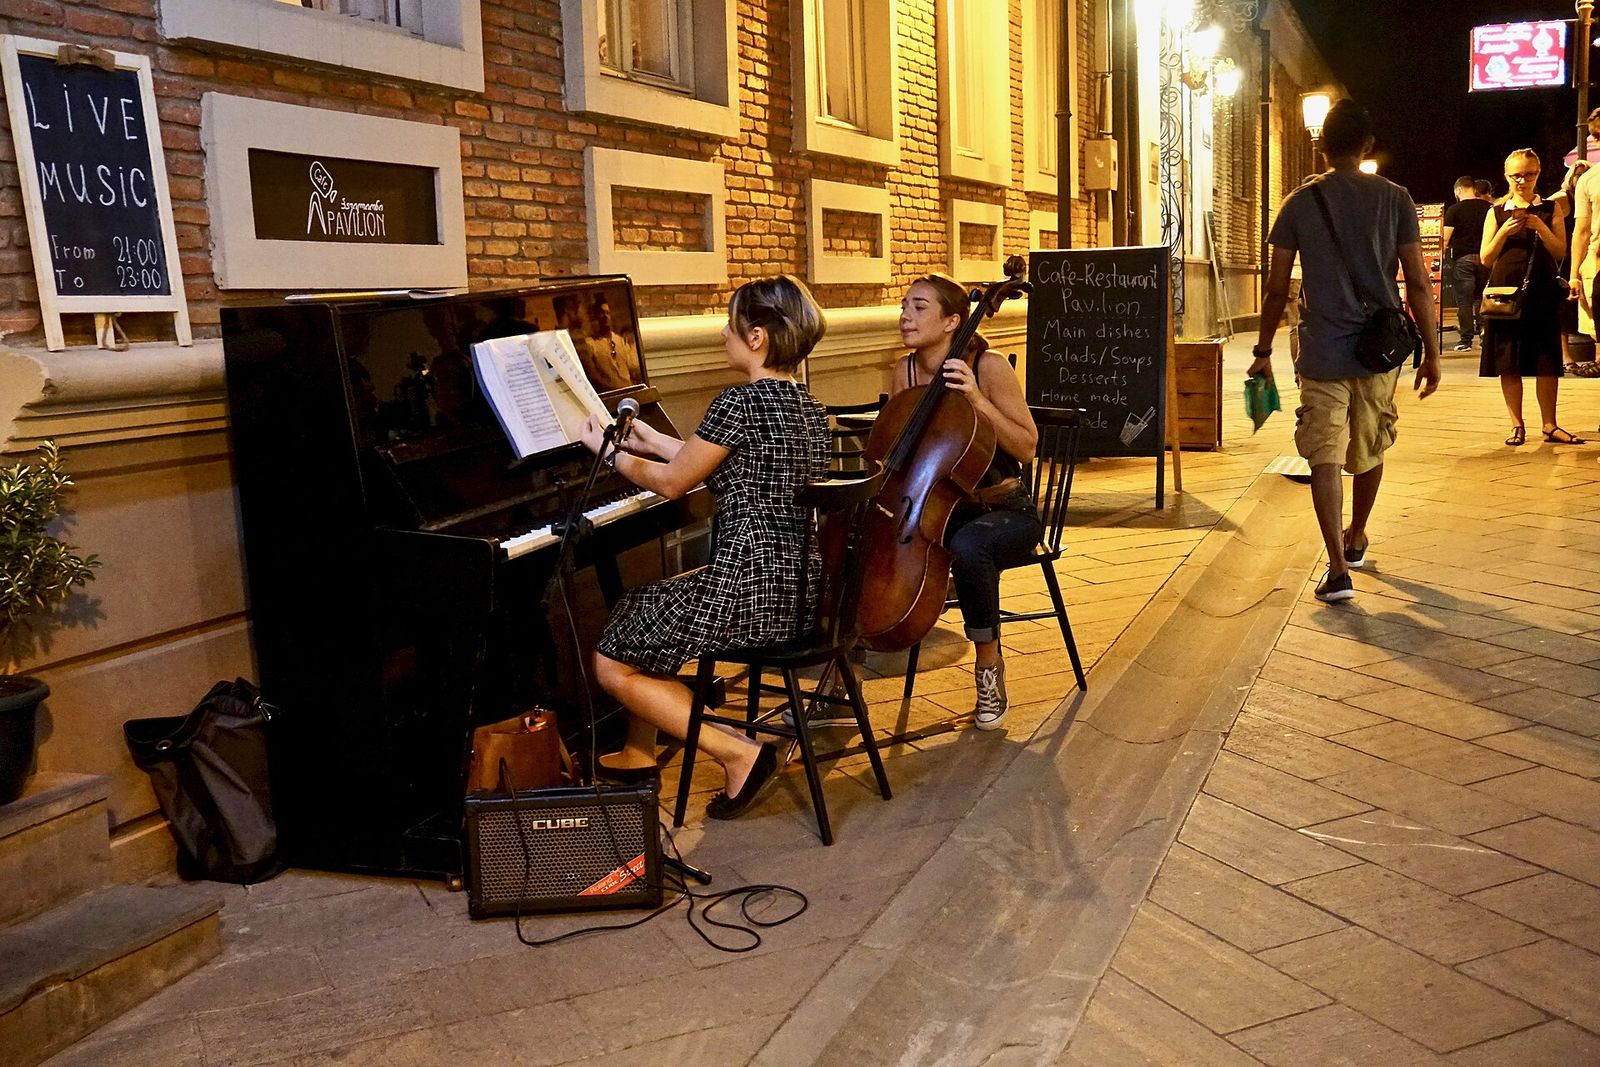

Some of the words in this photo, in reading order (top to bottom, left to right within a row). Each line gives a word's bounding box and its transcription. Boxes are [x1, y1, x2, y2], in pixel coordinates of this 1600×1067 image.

[327, 209, 386, 237] PAVILION
[51, 234, 96, 260] From
[112, 235, 158, 266] 21:00
[55, 269, 85, 290] To
[116, 265, 162, 289] 23:00
[1037, 259, 1158, 290] Cafe-Restaurant
[1061, 287, 1140, 316] Pavilion
[1043, 319, 1086, 340] Main
[1095, 322, 1151, 339] dishes
[1059, 366, 1127, 386] Desserts
[1041, 388, 1080, 403] Home
[1090, 389, 1128, 405] made
[532, 817, 588, 830] CUBE
